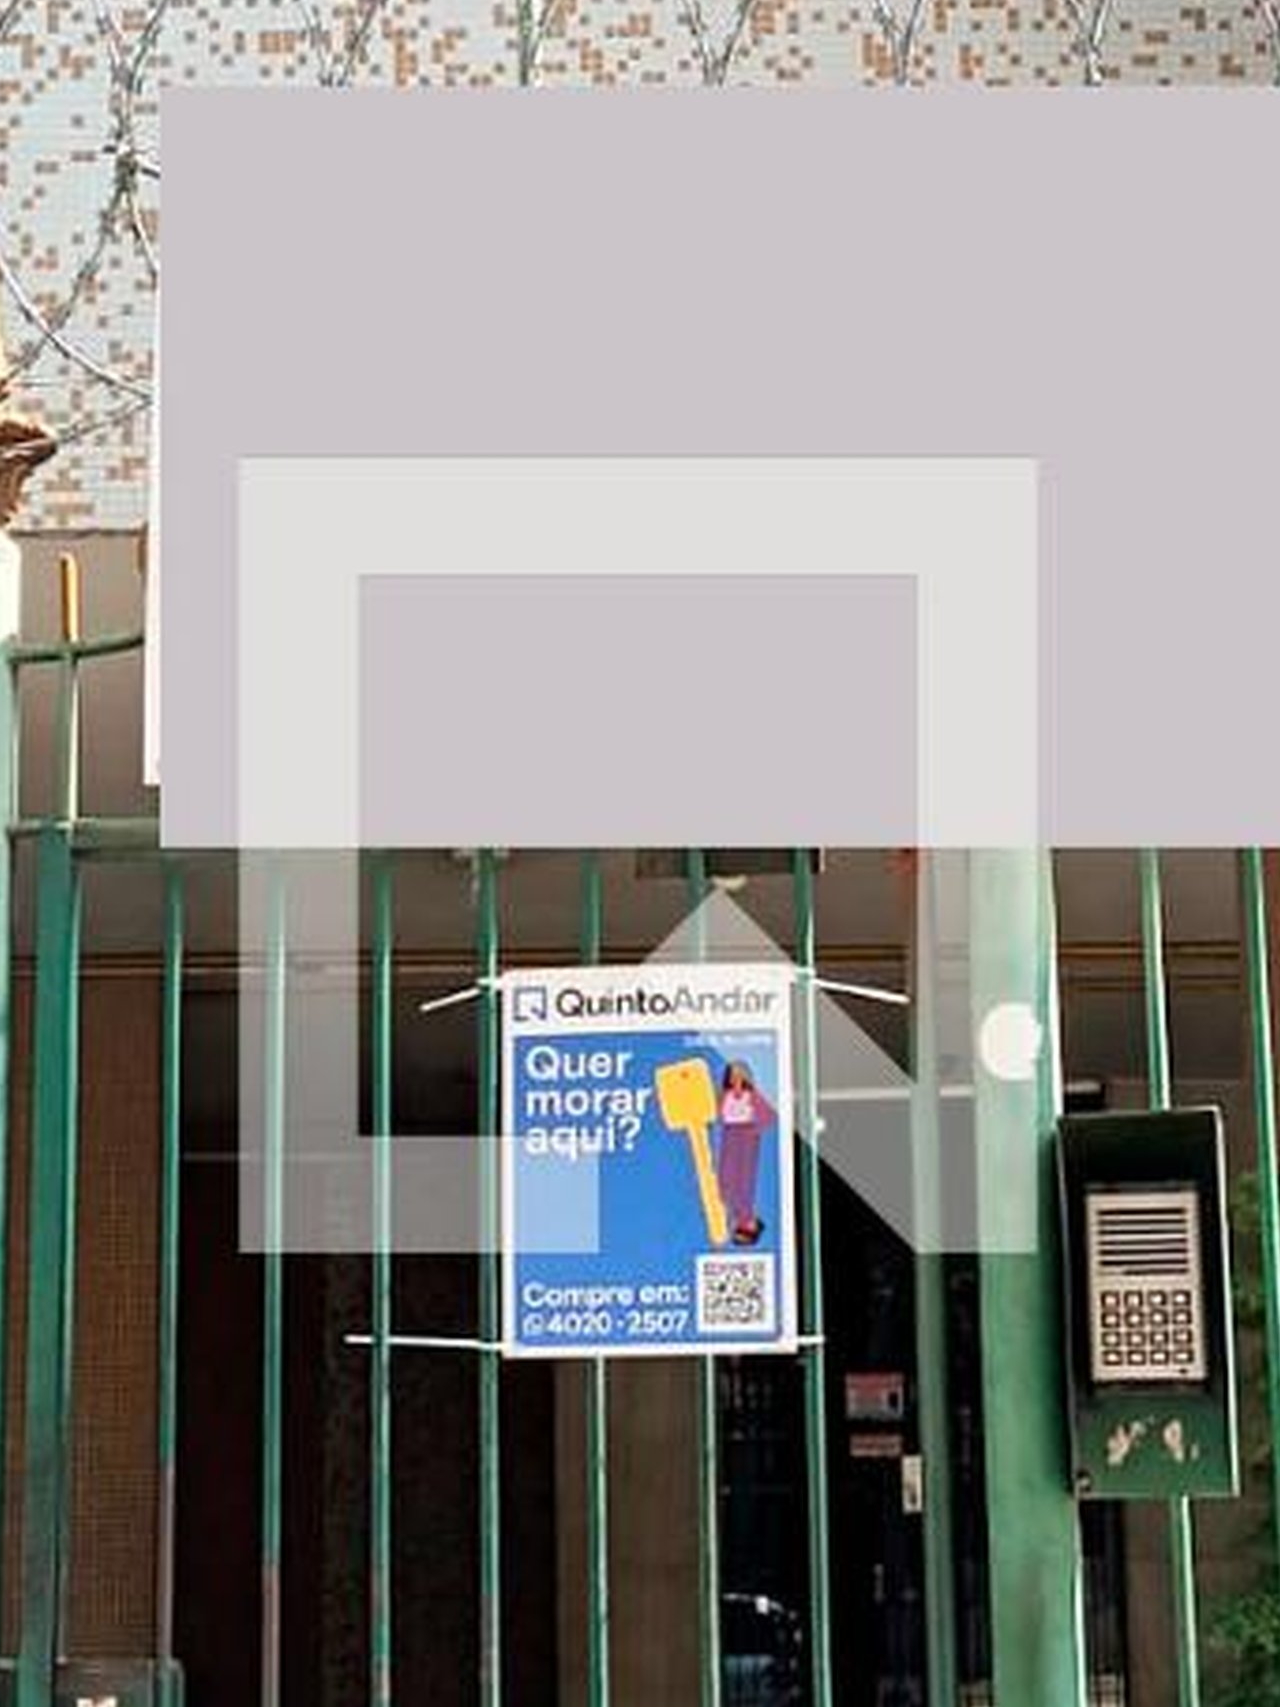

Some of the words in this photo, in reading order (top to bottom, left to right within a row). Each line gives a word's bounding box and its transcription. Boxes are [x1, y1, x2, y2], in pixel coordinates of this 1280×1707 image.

[556, 985, 776, 1017] QuintoAndar
[526, 1045, 632, 1080] Quer
[526, 1089, 652, 1115] morar
[525, 1115, 641, 1162] aqui?
[523, 1282, 634, 1312] Compre
[639, 1284, 690, 1304] em:
[547, 1311, 612, 1335] 4020
[626, 1309, 688, 1335] 2507
